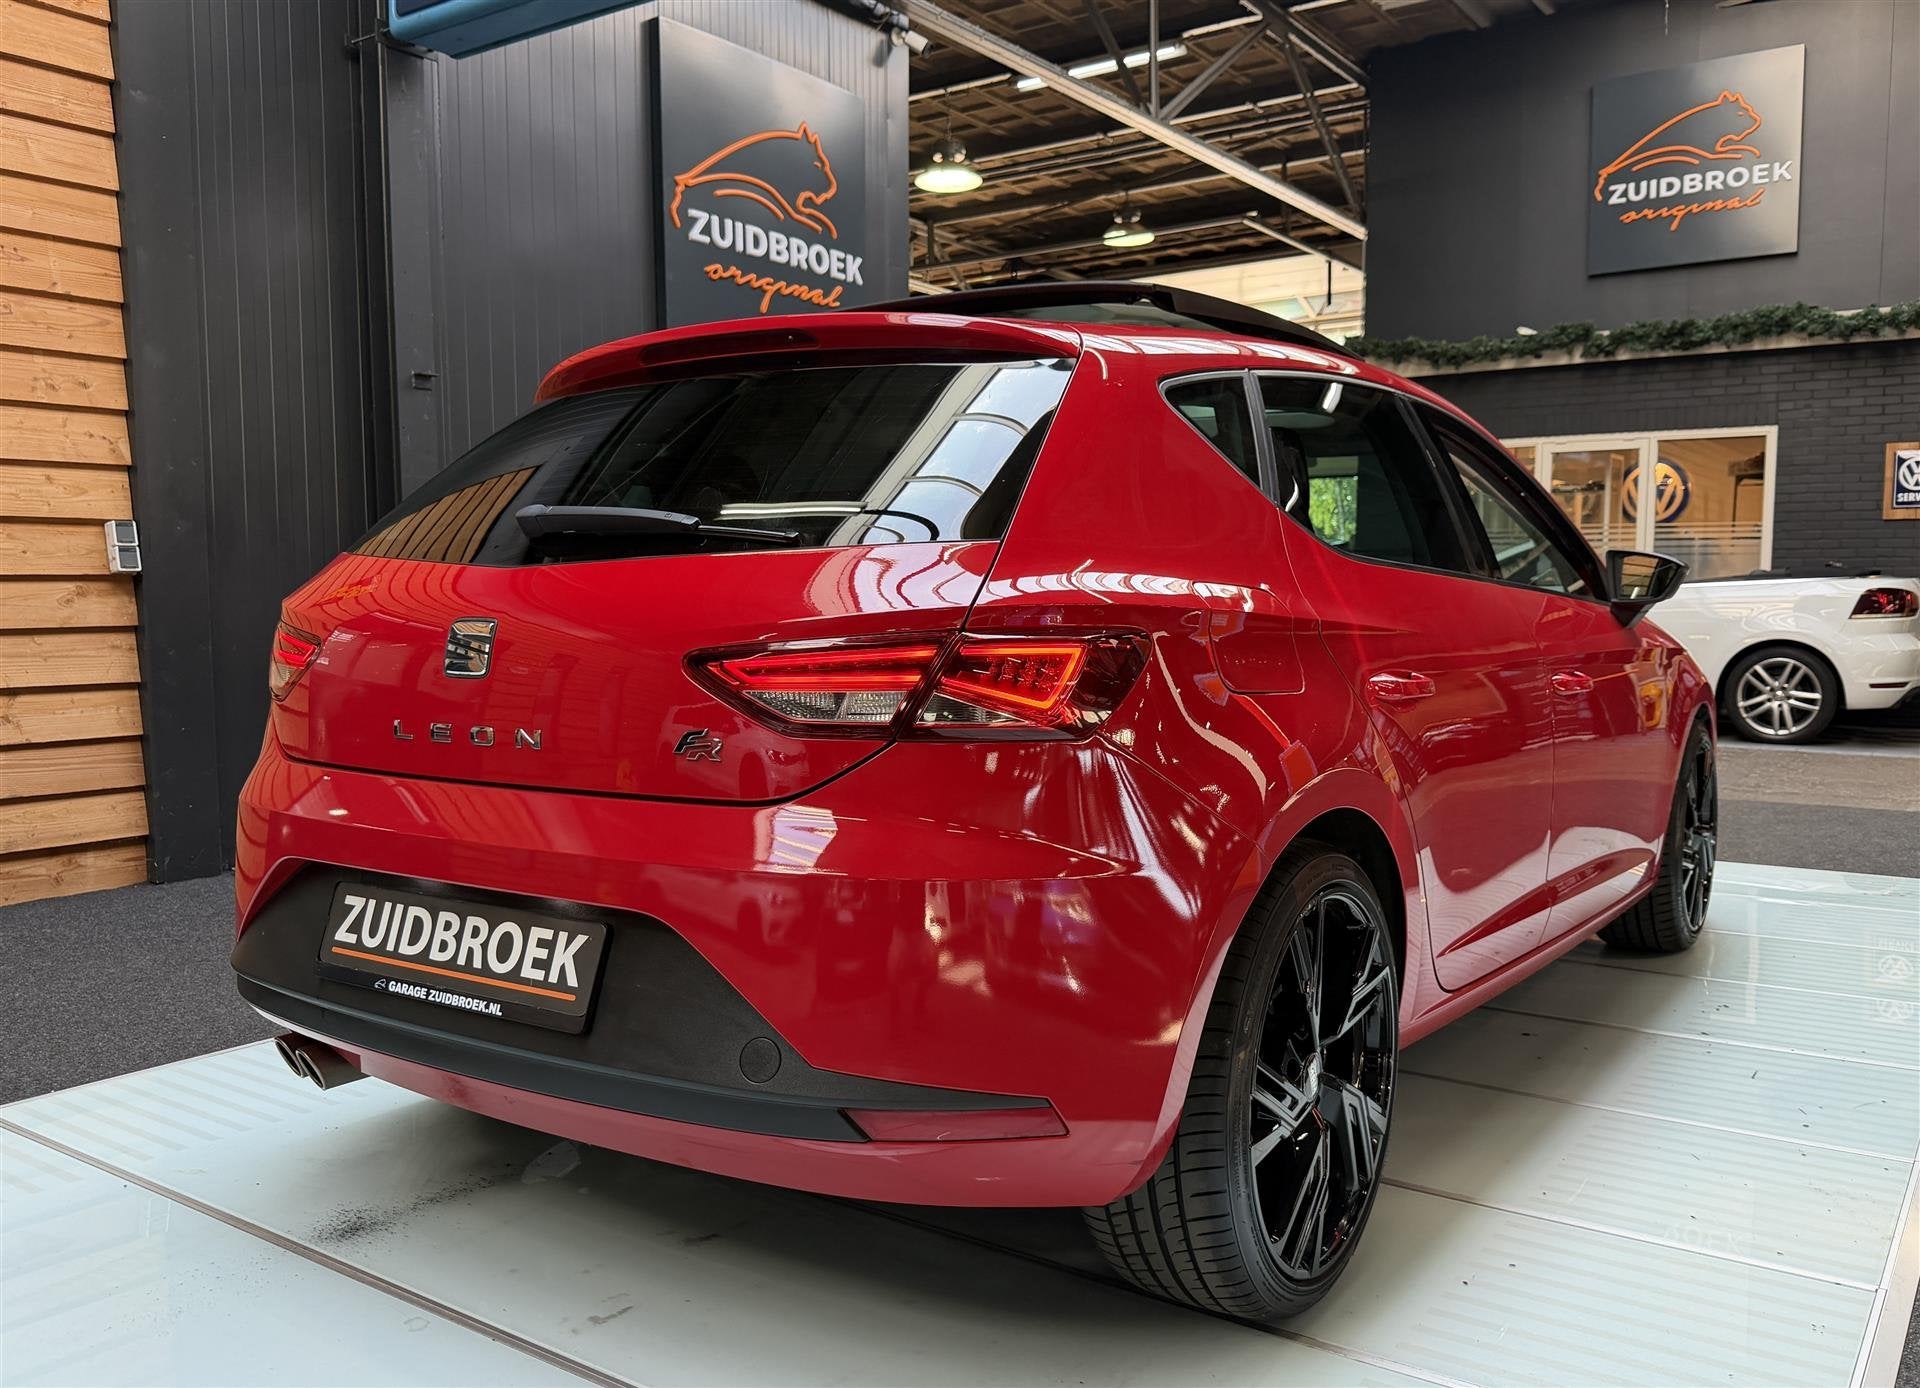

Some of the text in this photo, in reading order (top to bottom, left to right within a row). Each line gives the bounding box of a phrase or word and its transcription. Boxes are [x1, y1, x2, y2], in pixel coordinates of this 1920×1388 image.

[1608, 160, 1793, 205] ZUIDBROEK
[1620, 187, 1765, 231] original
[688, 208, 863, 286] ZUIDBROEK
[704, 263, 844, 313] original
[393, 719, 542, 749] LEON
[673, 727, 723, 762] FR
[334, 895, 590, 988] ZUIDBROEK
[388, 981, 503, 1016] GARAGE ZUIDBROEK.NL
